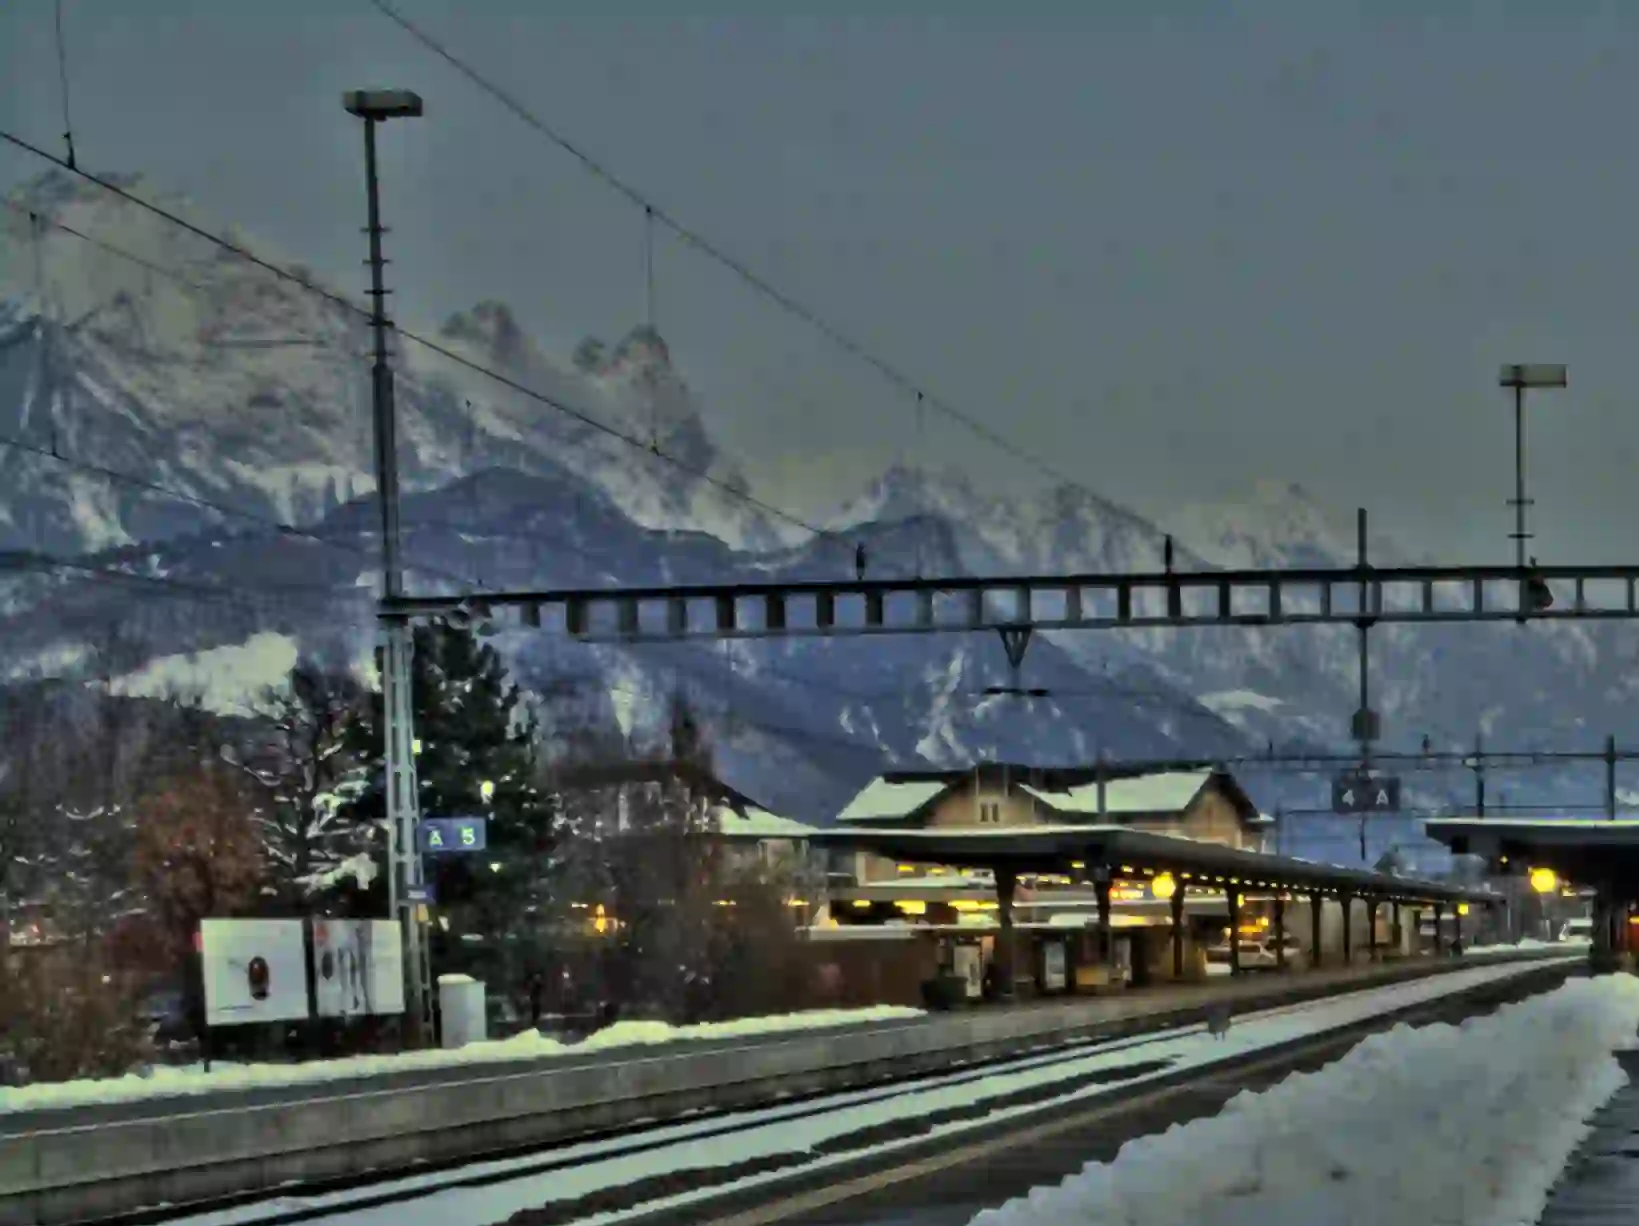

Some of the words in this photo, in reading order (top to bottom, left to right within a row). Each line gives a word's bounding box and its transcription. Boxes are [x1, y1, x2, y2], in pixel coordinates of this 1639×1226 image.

[1376, 789, 1389, 806] A
[429, 829, 443, 847] A
[462, 827, 475, 846] 5
